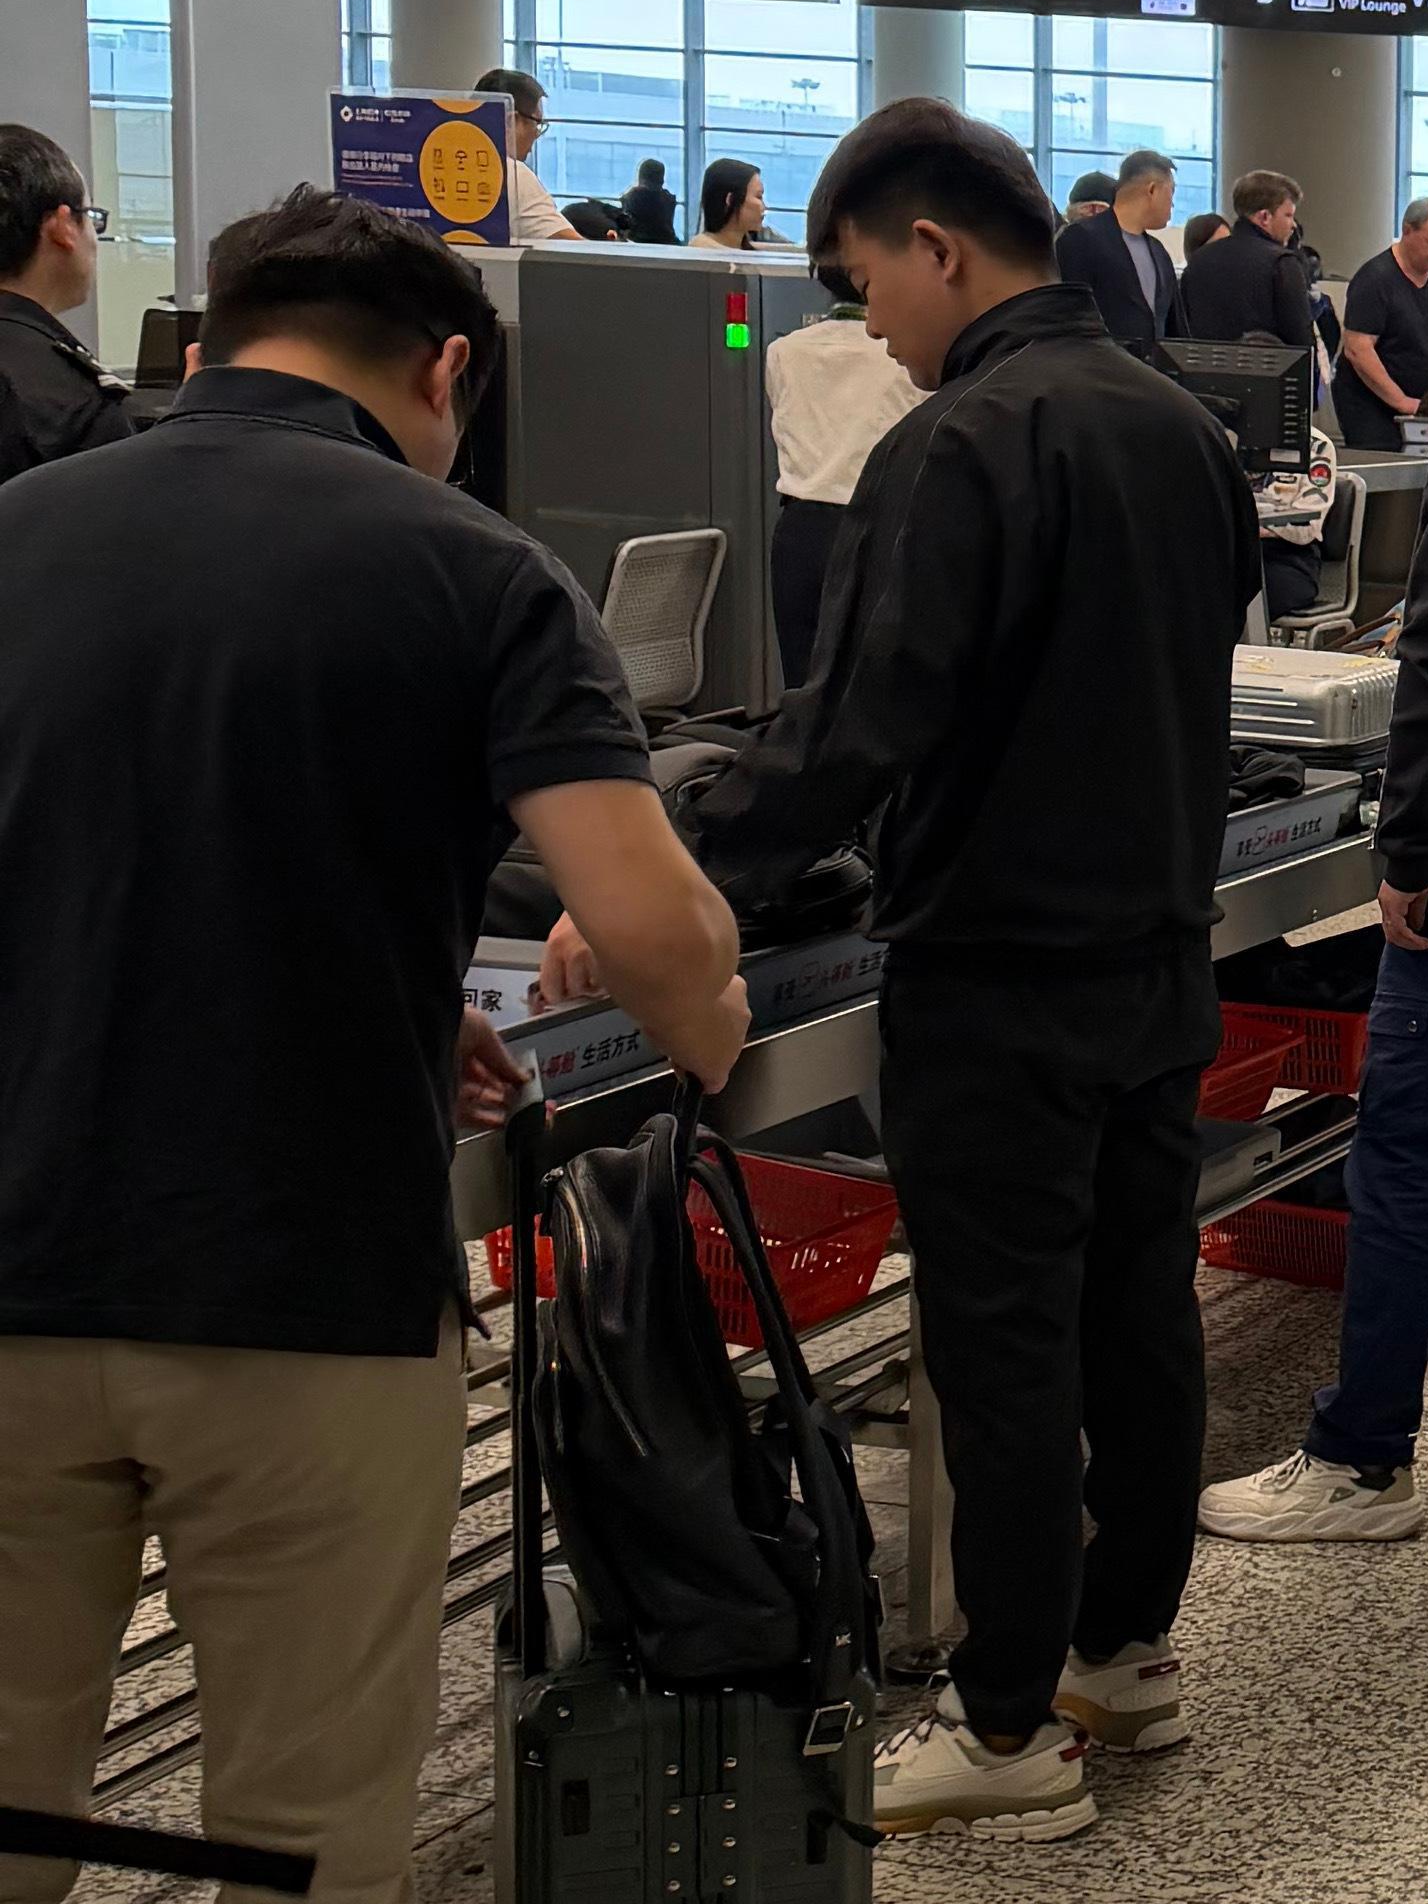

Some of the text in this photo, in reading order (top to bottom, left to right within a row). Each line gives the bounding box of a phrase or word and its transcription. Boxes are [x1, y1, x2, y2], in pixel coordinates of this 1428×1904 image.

[1360, 0, 1407, 15] Lounge
[580, 1028, 641, 1069] 生活方式
